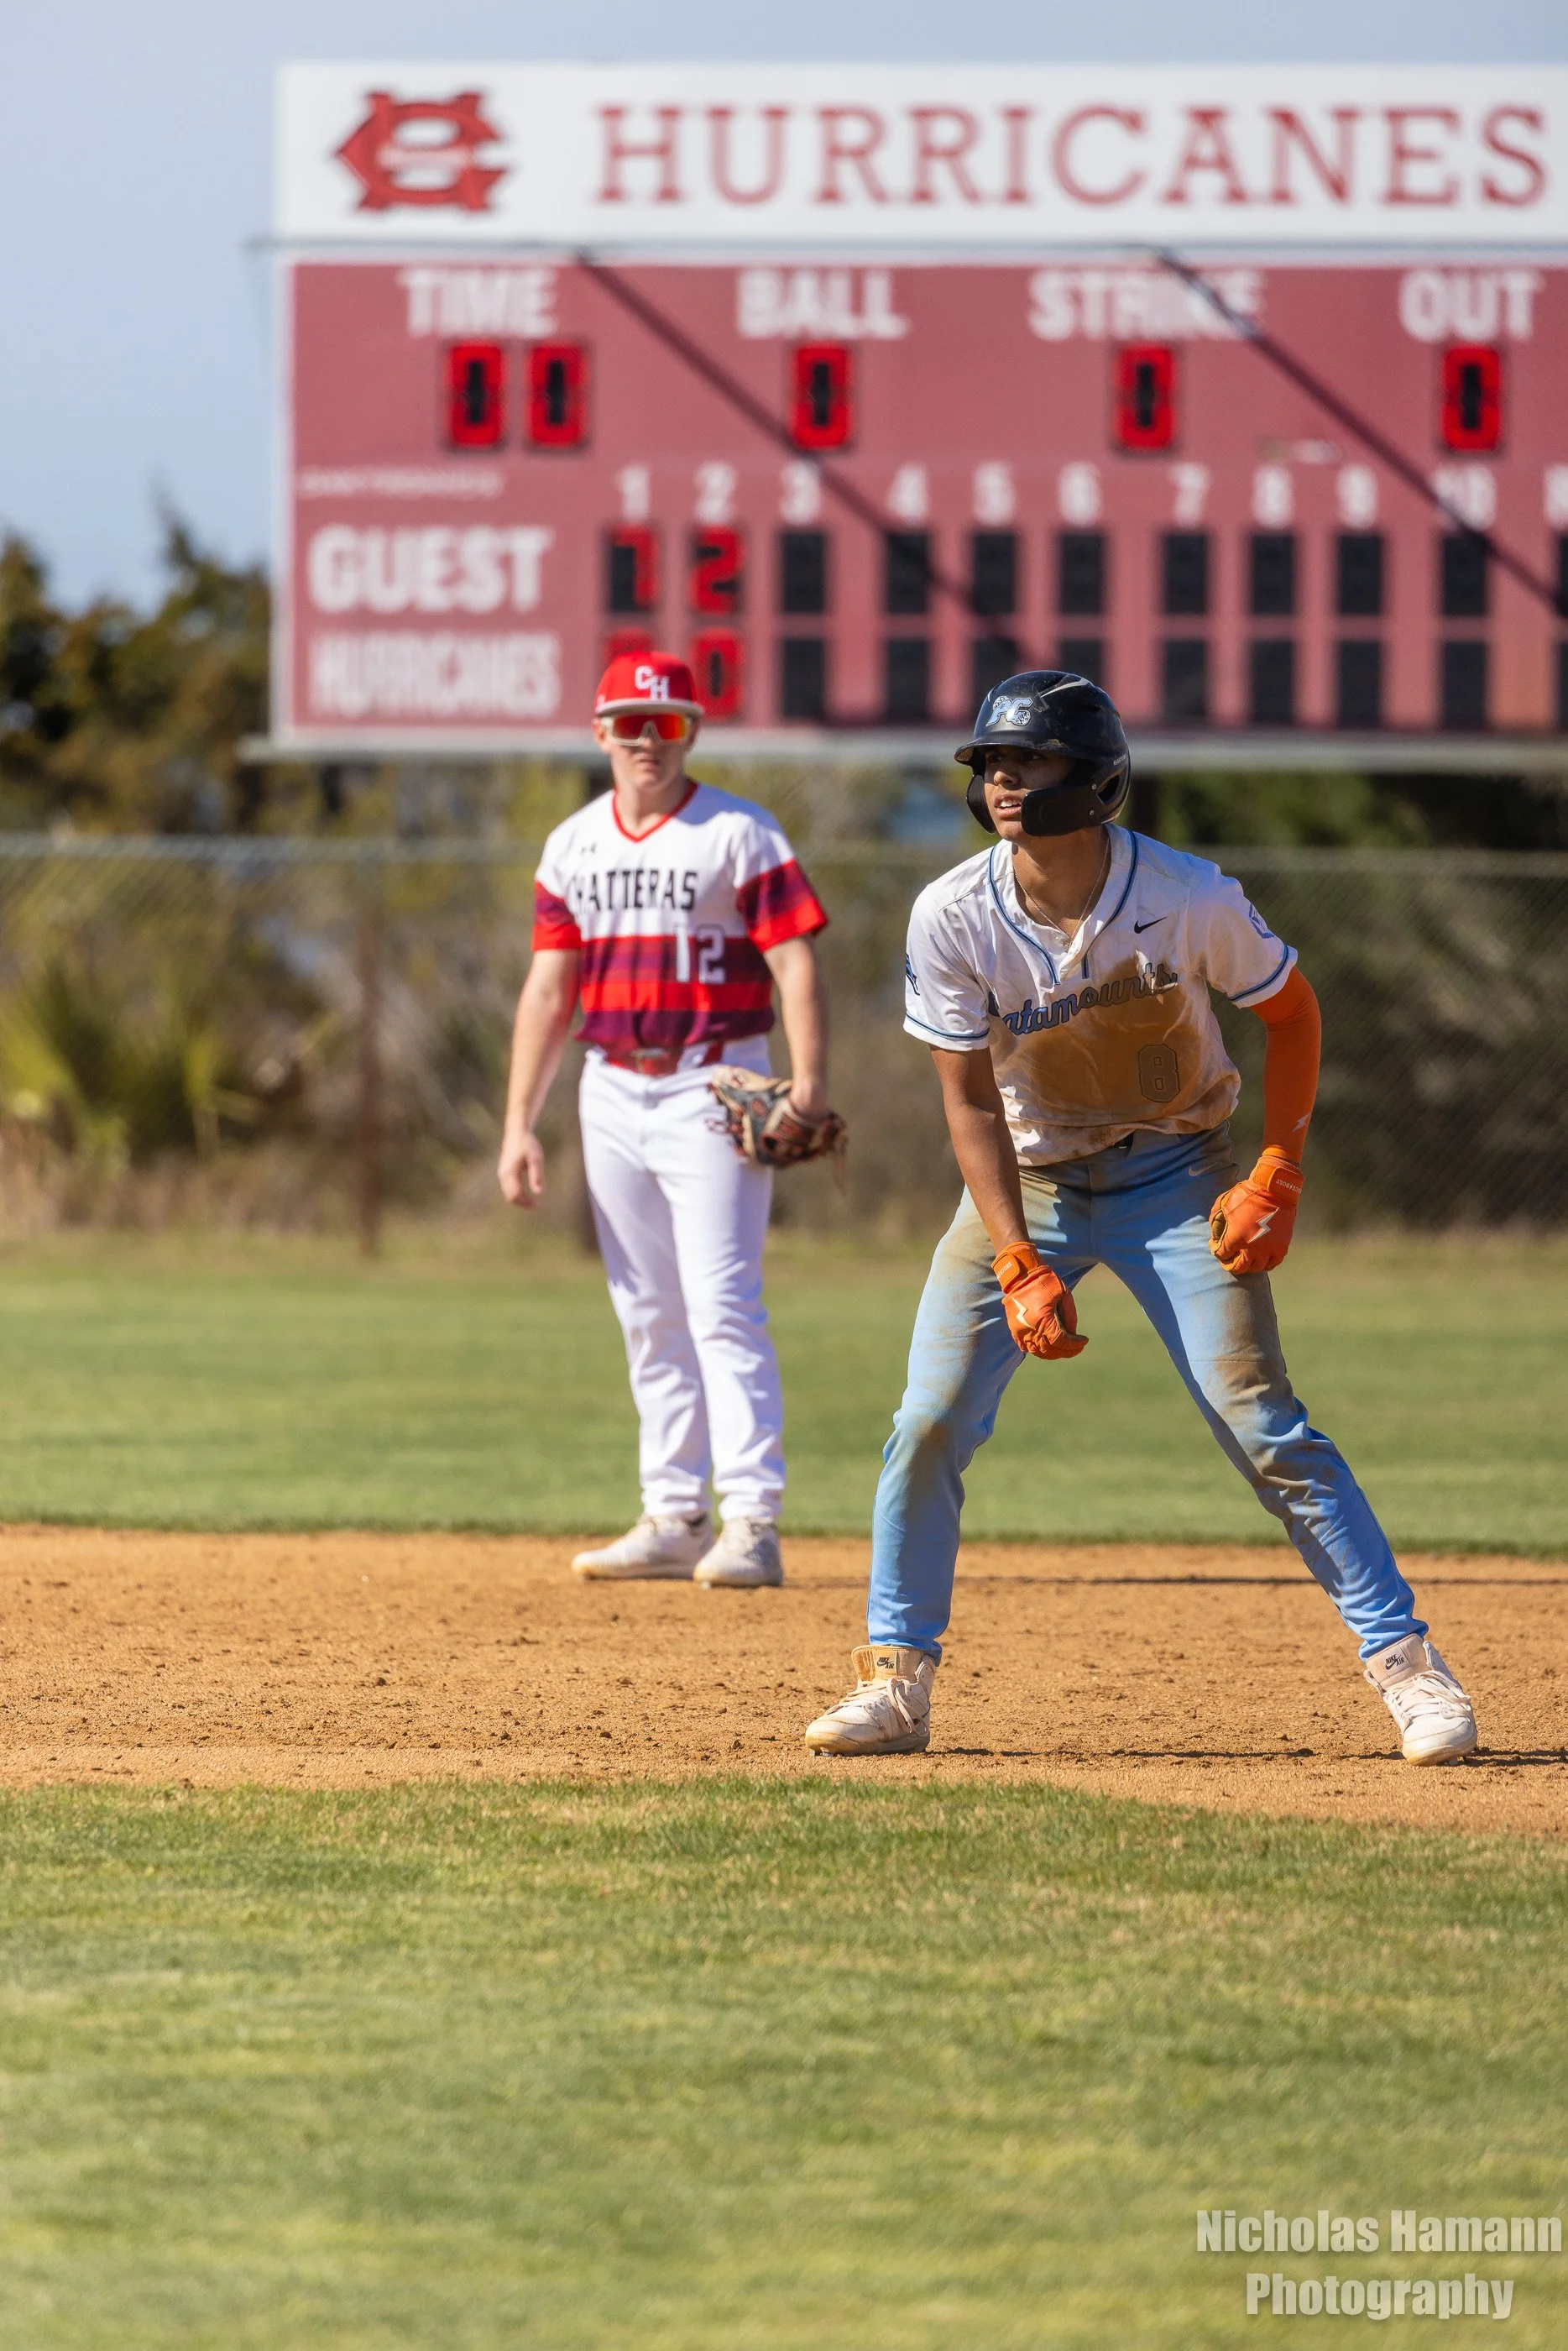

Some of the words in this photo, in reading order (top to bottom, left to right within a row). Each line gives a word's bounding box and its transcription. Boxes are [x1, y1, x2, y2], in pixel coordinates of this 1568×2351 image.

[598, 102, 1547, 207] HURRICANES
[400, 270, 556, 337] TIME
[737, 270, 906, 338] BALL
[1399, 270, 1541, 339] OUT
[792, 343, 850, 449] 0
[1115, 344, 1174, 452] 0
[1441, 344, 1502, 452] 0
[617, 463, 651, 522] 1
[696, 462, 736, 525] 2
[781, 463, 821, 524] 3
[888, 463, 929, 522] 4
[1170, 463, 1210, 526] 7
[308, 525, 552, 613] GUEST
[692, 524, 747, 614] 2
[635, 665, 669, 702] CH
[675, 922, 726, 984] 12
[1138, 1044, 1180, 1103] 8
[1386, 1654, 1397, 1665] NIKE
[1396, 1657, 1405, 1666] AIR
